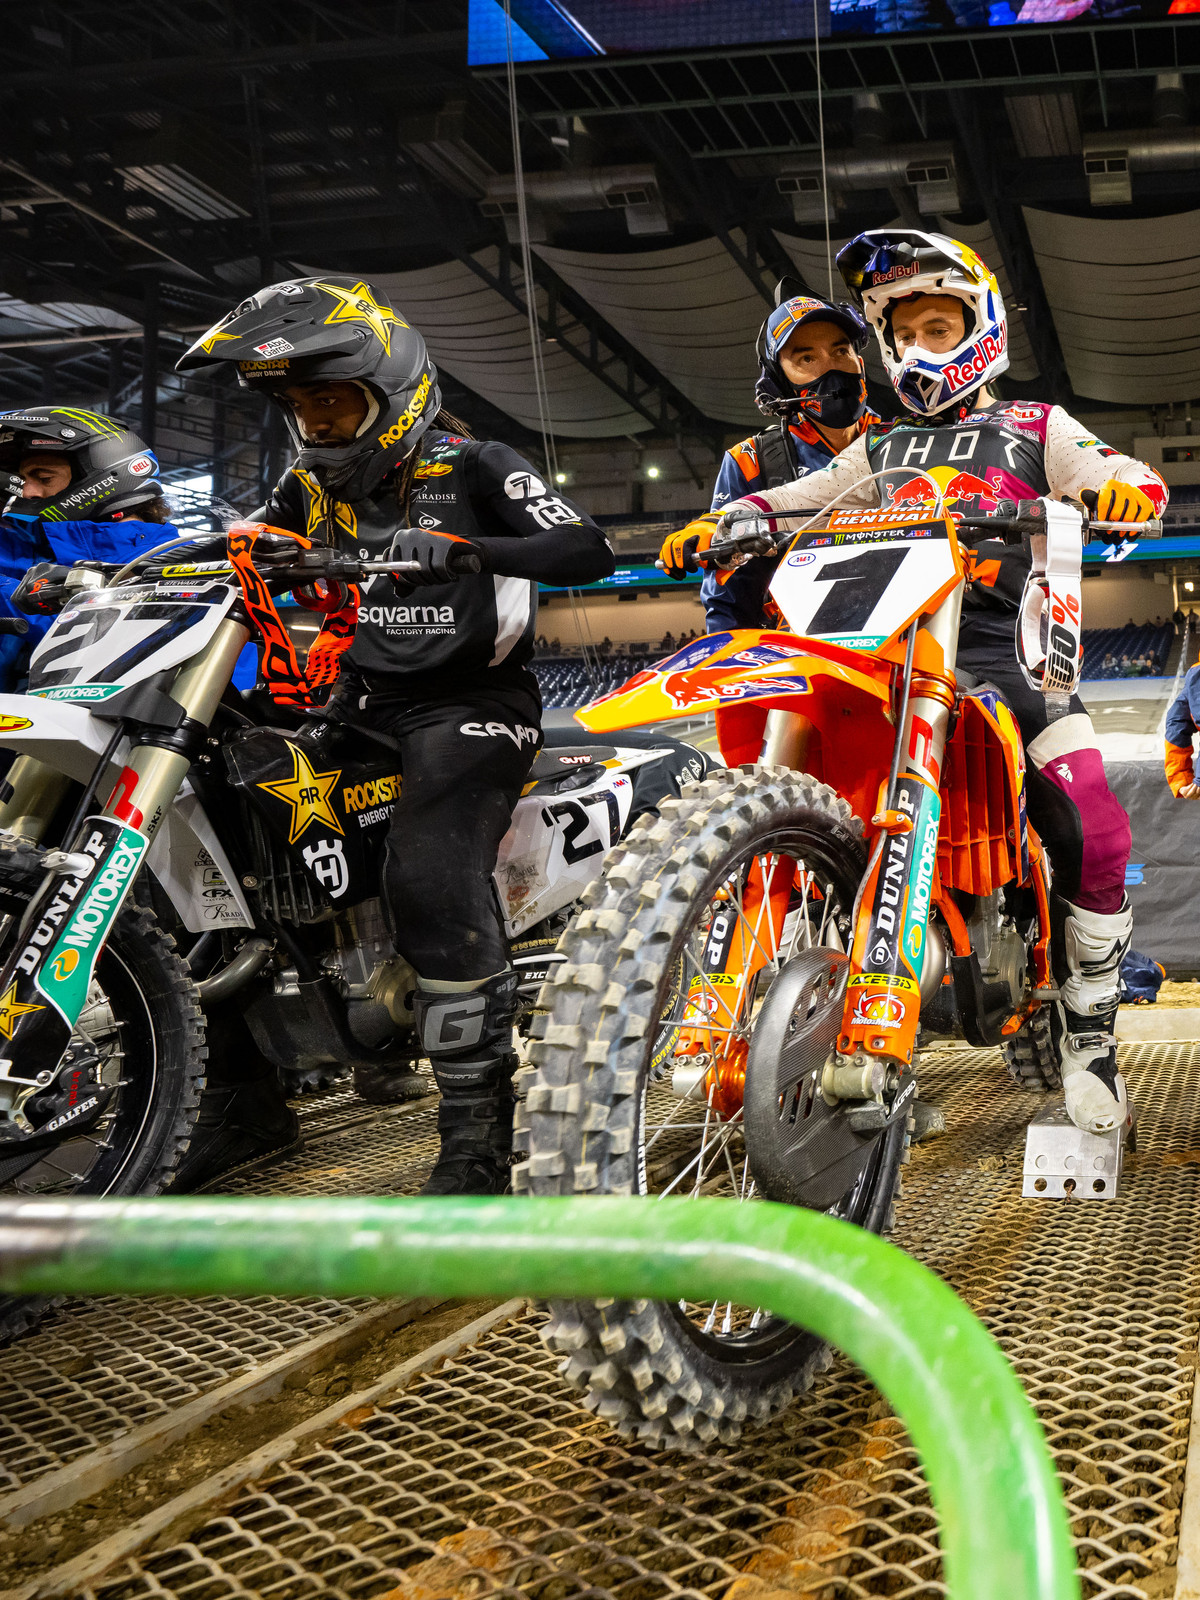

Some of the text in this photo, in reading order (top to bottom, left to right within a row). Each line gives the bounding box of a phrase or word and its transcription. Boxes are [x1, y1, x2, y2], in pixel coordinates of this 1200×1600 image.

[872, 261, 919, 286] Red Bull
[262, 343, 293, 358] Garcia
[267, 338, 287, 351] Abu
[941, 320, 1008, 392] Red Bull
[264, 369, 287, 377] DRINK
[377, 373, 433, 450] ROCKSTAR
[132, 460, 150, 473] BELL
[60, 475, 119, 510] MONSTER
[78, 486, 117, 510] ENERGY
[510, 475, 532, 498] 7
[833, 512, 930, 525] RENTHAL
[807, 529, 932, 546] AMA MONSTER AMA
[854, 537, 896, 545] ENERGY
[793, 556, 812, 564] AMA
[805, 546, 912, 636] 1
[357, 604, 455, 627] sqvarna
[386, 627, 457, 636] FACTORY RACING
[29, 605, 212, 692] 27
[46, 687, 111, 700] MOTOREX
[559, 755, 593, 765] GUTS
[342, 773, 403, 815] ROCKST
[613, 778, 630, 789] AMA
[147, 805, 164, 836] SKF
[357, 807, 391, 829] ENERGY
[541, 788, 622, 867] 27
[876, 789, 916, 936] DUNLP
[911, 817, 941, 925] MOTOREX
[63, 845, 144, 949] MOTOREX
[524, 971, 549, 980] EXC
[691, 976, 736, 988] CERBIS
[850, 975, 913, 990] ACERBIS
[424, 997, 487, 1052] G
[69, 1070, 83, 1107] bremb
[48, 1096, 99, 1132] GALFER
